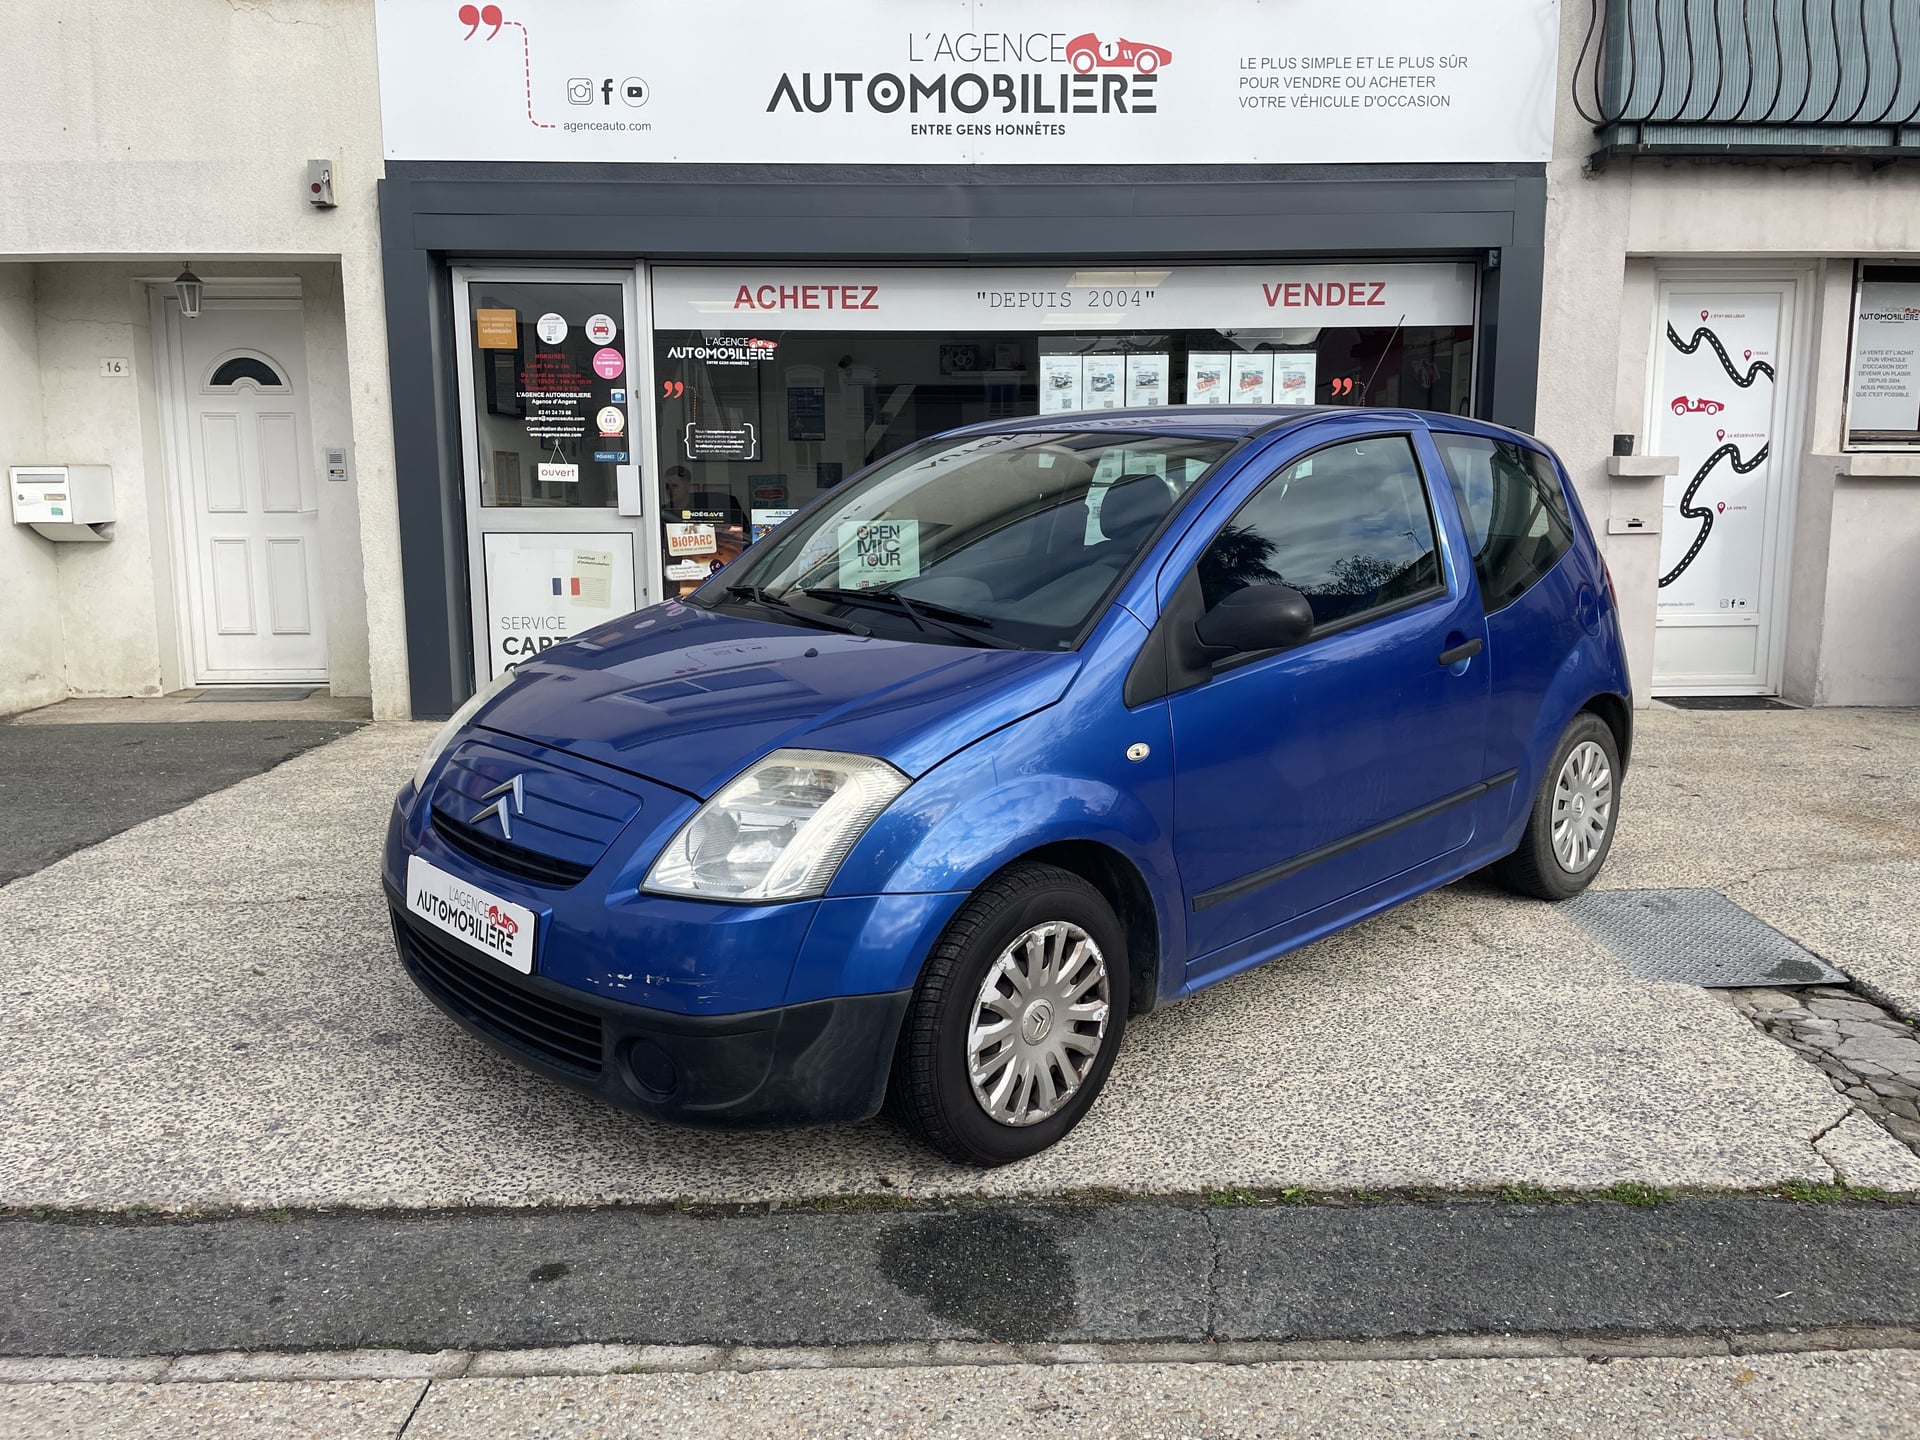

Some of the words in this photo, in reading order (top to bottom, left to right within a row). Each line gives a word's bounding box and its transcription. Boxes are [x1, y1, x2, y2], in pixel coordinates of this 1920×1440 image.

[909, 32, 1066, 62] L'AGENCE
[1104, 43, 1114, 58] 1
[1240, 57, 1257, 70] LE
[1260, 57, 1297, 70] PLUS
[1301, 57, 1351, 69] SIMPLE
[1356, 57, 1374, 69] ET
[1378, 56, 1394, 68] LE
[1398, 56, 1435, 68] PLUS
[1438, 54, 1468, 68] SÛR
[1239, 77, 1280, 89] POUR
[1284, 76, 1341, 88] VENDRE
[1345, 76, 1366, 88] OU
[1368, 76, 1436, 88] ACHETER
[1238, 96, 1286, 108] VOTRE
[1290, 94, 1360, 108] VÉHICULE
[1364, 96, 1450, 108] D'OCCASION
[563, 121, 652, 132] agenceauto.com
[911, 124, 952, 136] ENTRE
[956, 124, 992, 136] GENS
[995, 121, 1066, 136] HONNÊTES
[734, 285, 879, 310] ACHETEZ
[1262, 282, 1386, 308] VENDEZ
[706, 338, 748, 346] L'AGENCE
[106, 362, 121, 373] 16
[541, 468, 575, 477] ouvert
[857, 525, 900, 540] OPEN
[857, 539, 900, 554] MIC
[857, 553, 901, 567] TOUR
[501, 616, 567, 630] SERVICE
[449, 886, 489, 918] L'AGENCE
